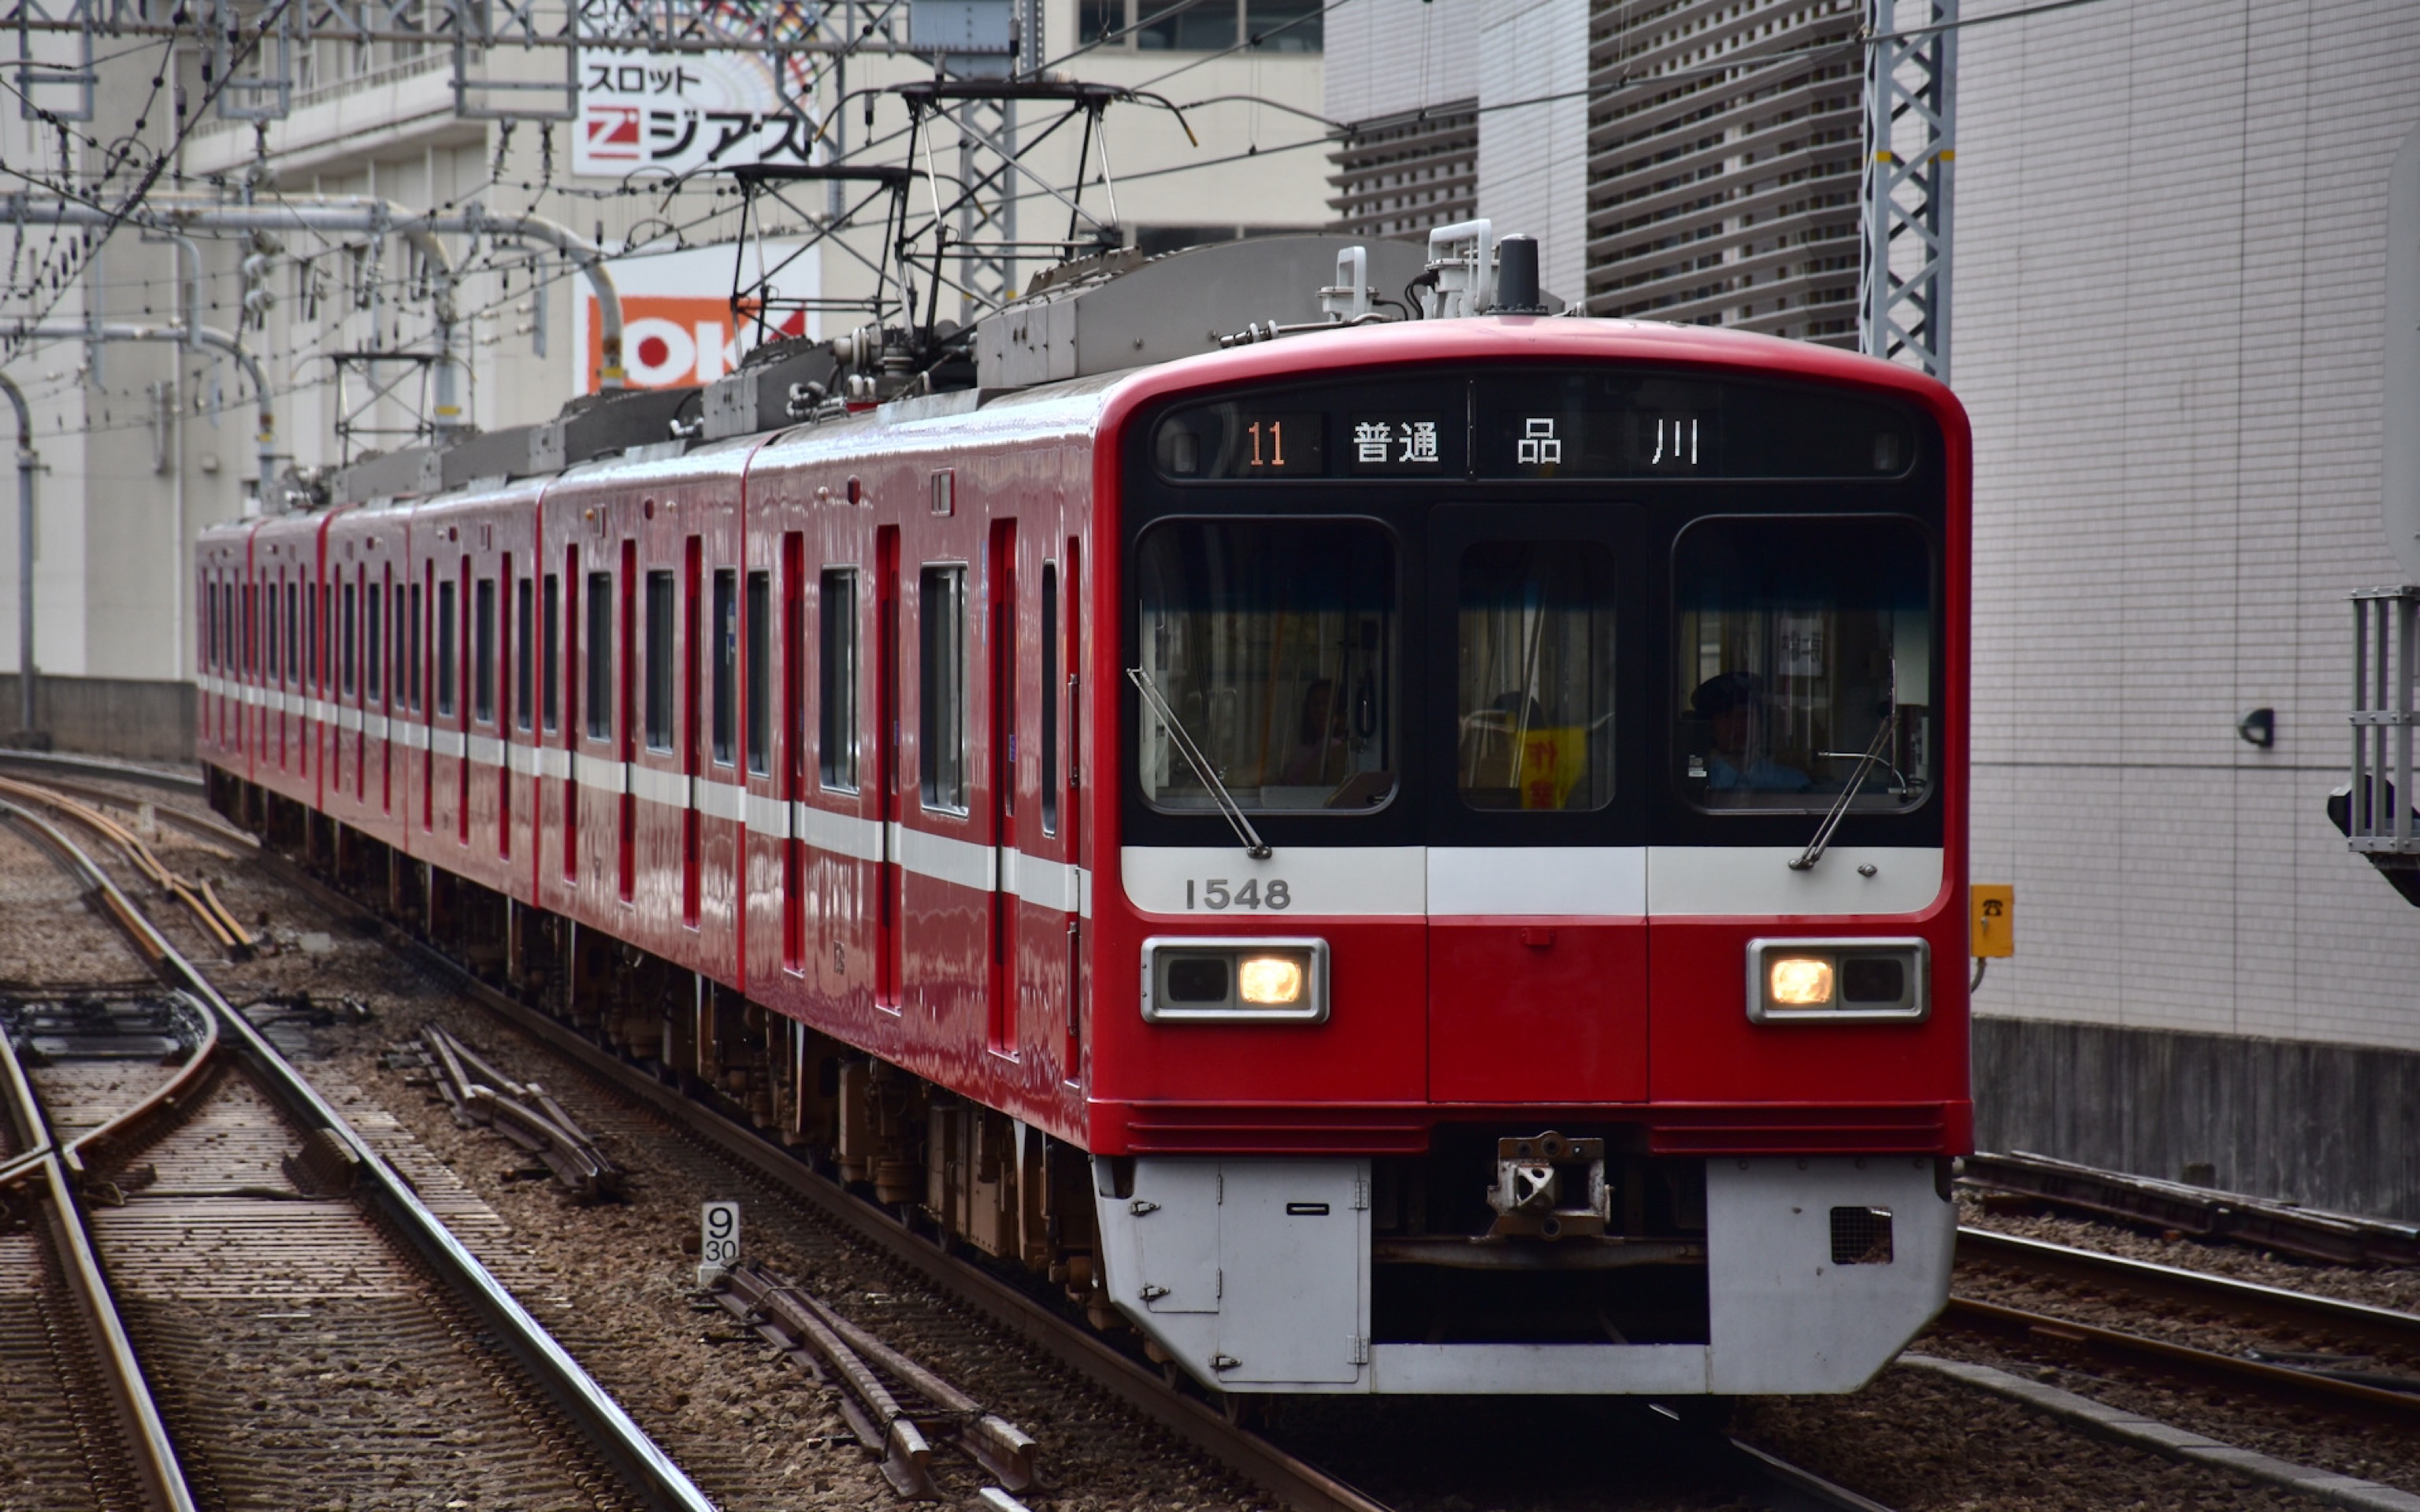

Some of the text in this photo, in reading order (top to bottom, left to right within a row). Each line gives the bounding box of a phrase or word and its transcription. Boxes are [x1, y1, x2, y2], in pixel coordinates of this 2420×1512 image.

[588, 65, 701, 94] スロット
[649, 109, 809, 161] ジアス
[1248, 421, 1286, 466] 11
[1353, 421, 1439, 463] 普通
[1186, 878, 1291, 910] 1548
[708, 1206, 733, 1240] 9
[705, 1240, 737, 1262] 30
